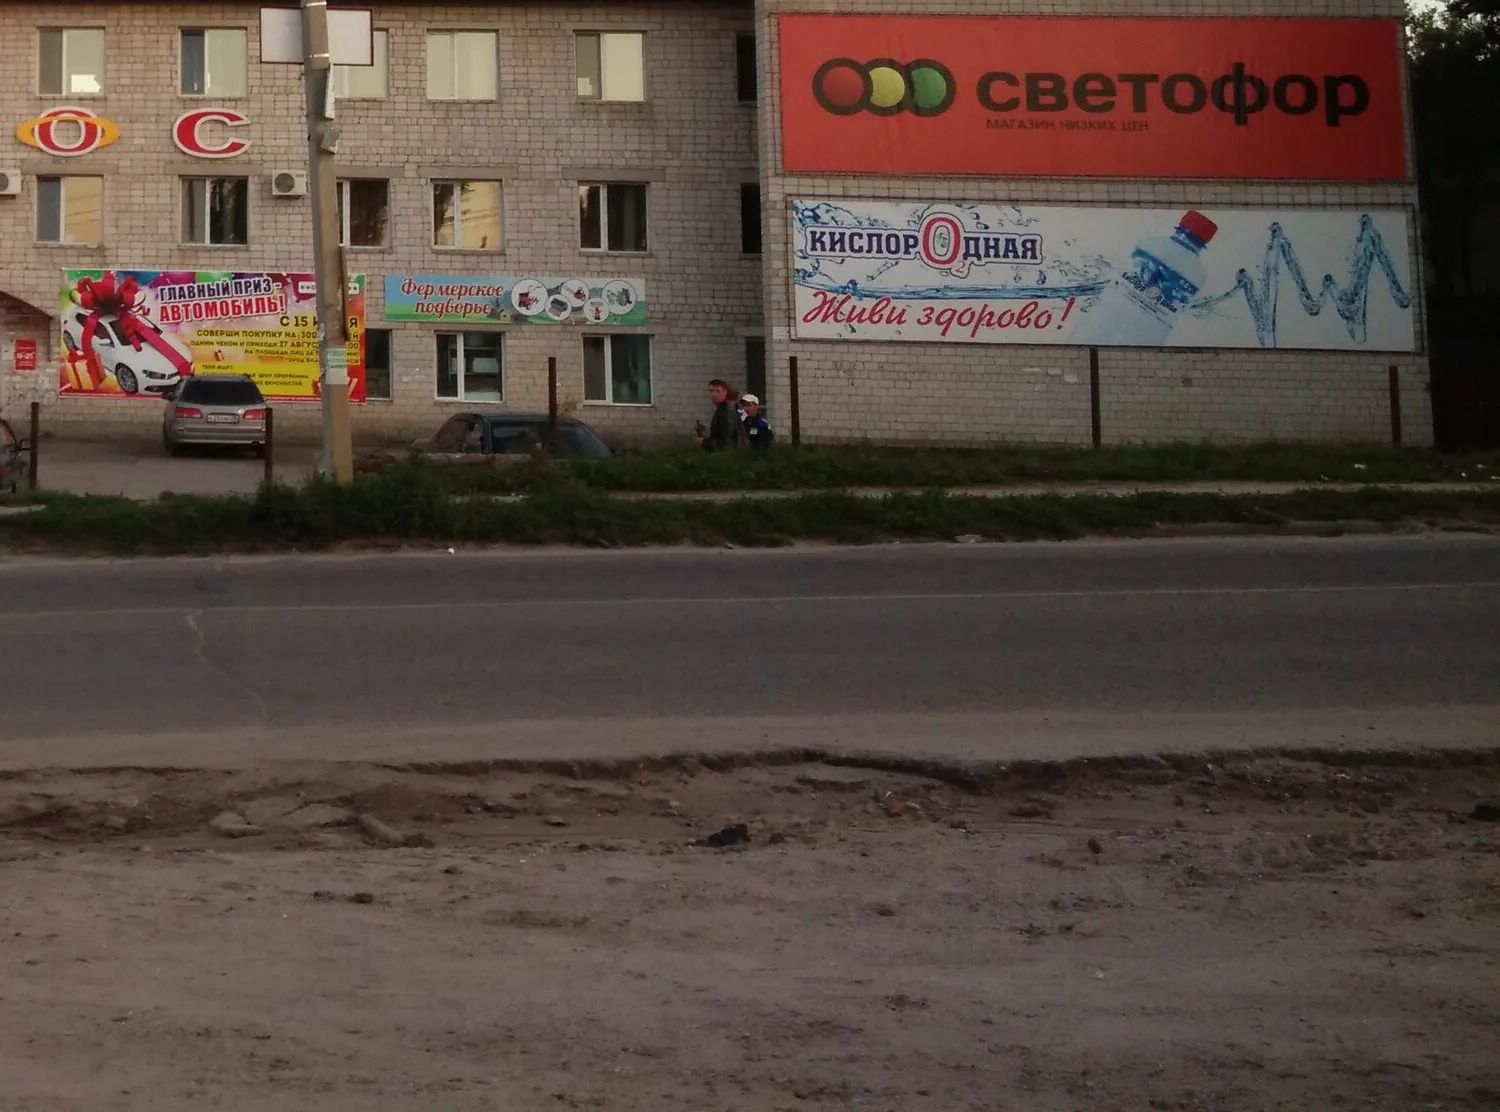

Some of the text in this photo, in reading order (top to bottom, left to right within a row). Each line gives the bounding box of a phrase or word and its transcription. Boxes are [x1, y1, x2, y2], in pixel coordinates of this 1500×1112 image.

[986, 119, 1149, 133] МАГАЗИН НИЗКИХ ЦЕН
[160, 279, 231, 301] ГЛАВНЫЙ
[234, 278, 272, 295] ПРИЗ
[401, 277, 504, 300] Фермерское
[160, 295, 286, 322] АВТОМОБИЛЬ!
[415, 299, 492, 319] подворье
[802, 290, 1077, 338] Живи здорово!
[280, 315, 290, 327] С
[294, 316, 308, 327] 15
[196, 329, 240, 338] СОВЕРШИ
[242, 330, 283, 338] ПОКУПКУ
[285, 331, 296, 339] НА
